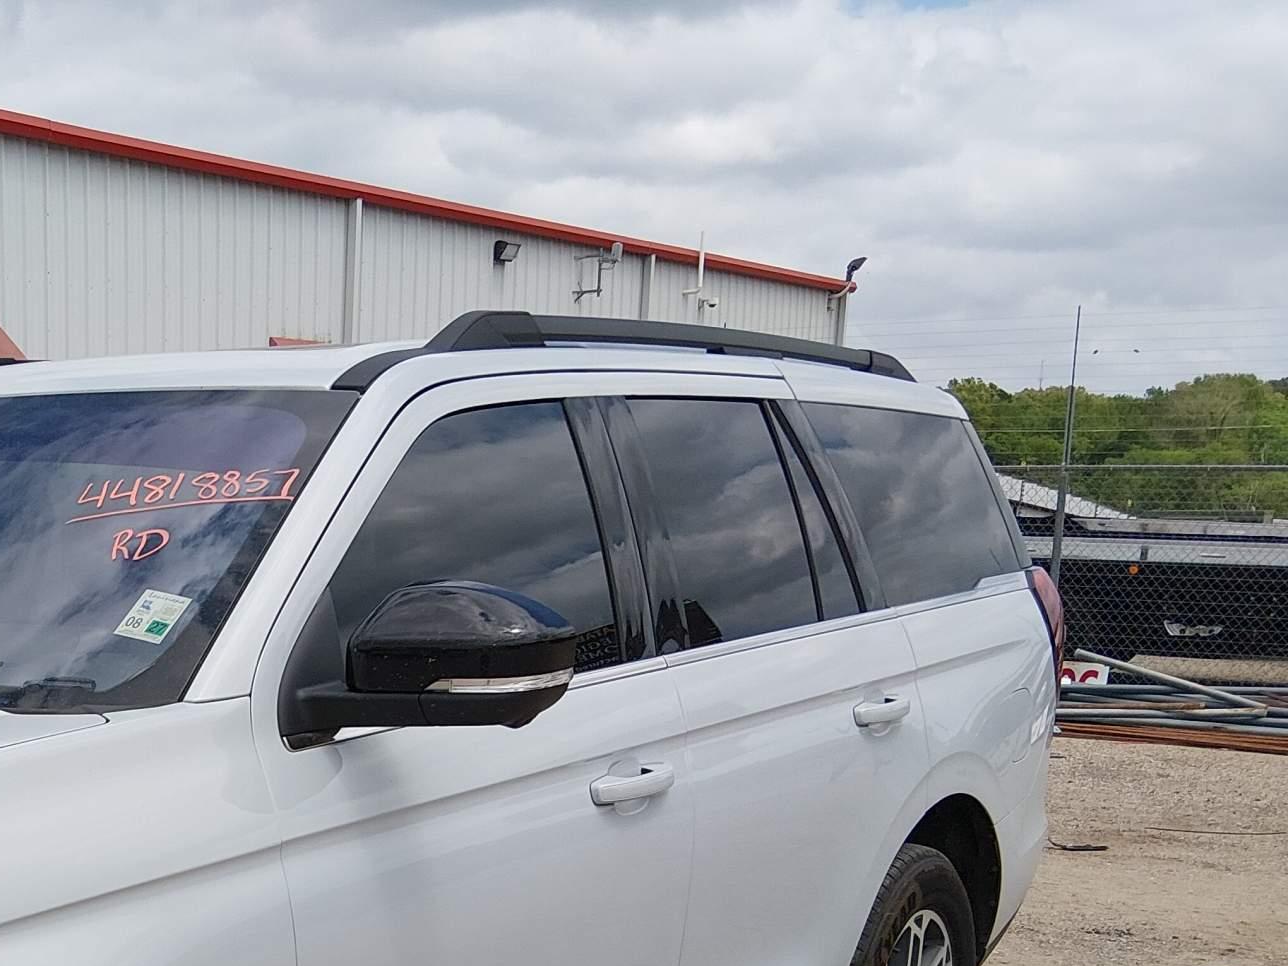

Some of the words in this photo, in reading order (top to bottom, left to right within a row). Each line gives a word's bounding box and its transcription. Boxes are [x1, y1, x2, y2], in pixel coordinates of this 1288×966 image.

[77, 468, 300, 509] 44818857
[111, 527, 171, 561] RD
[124, 615, 144, 629] 08
[148, 620, 169, 636] 27
